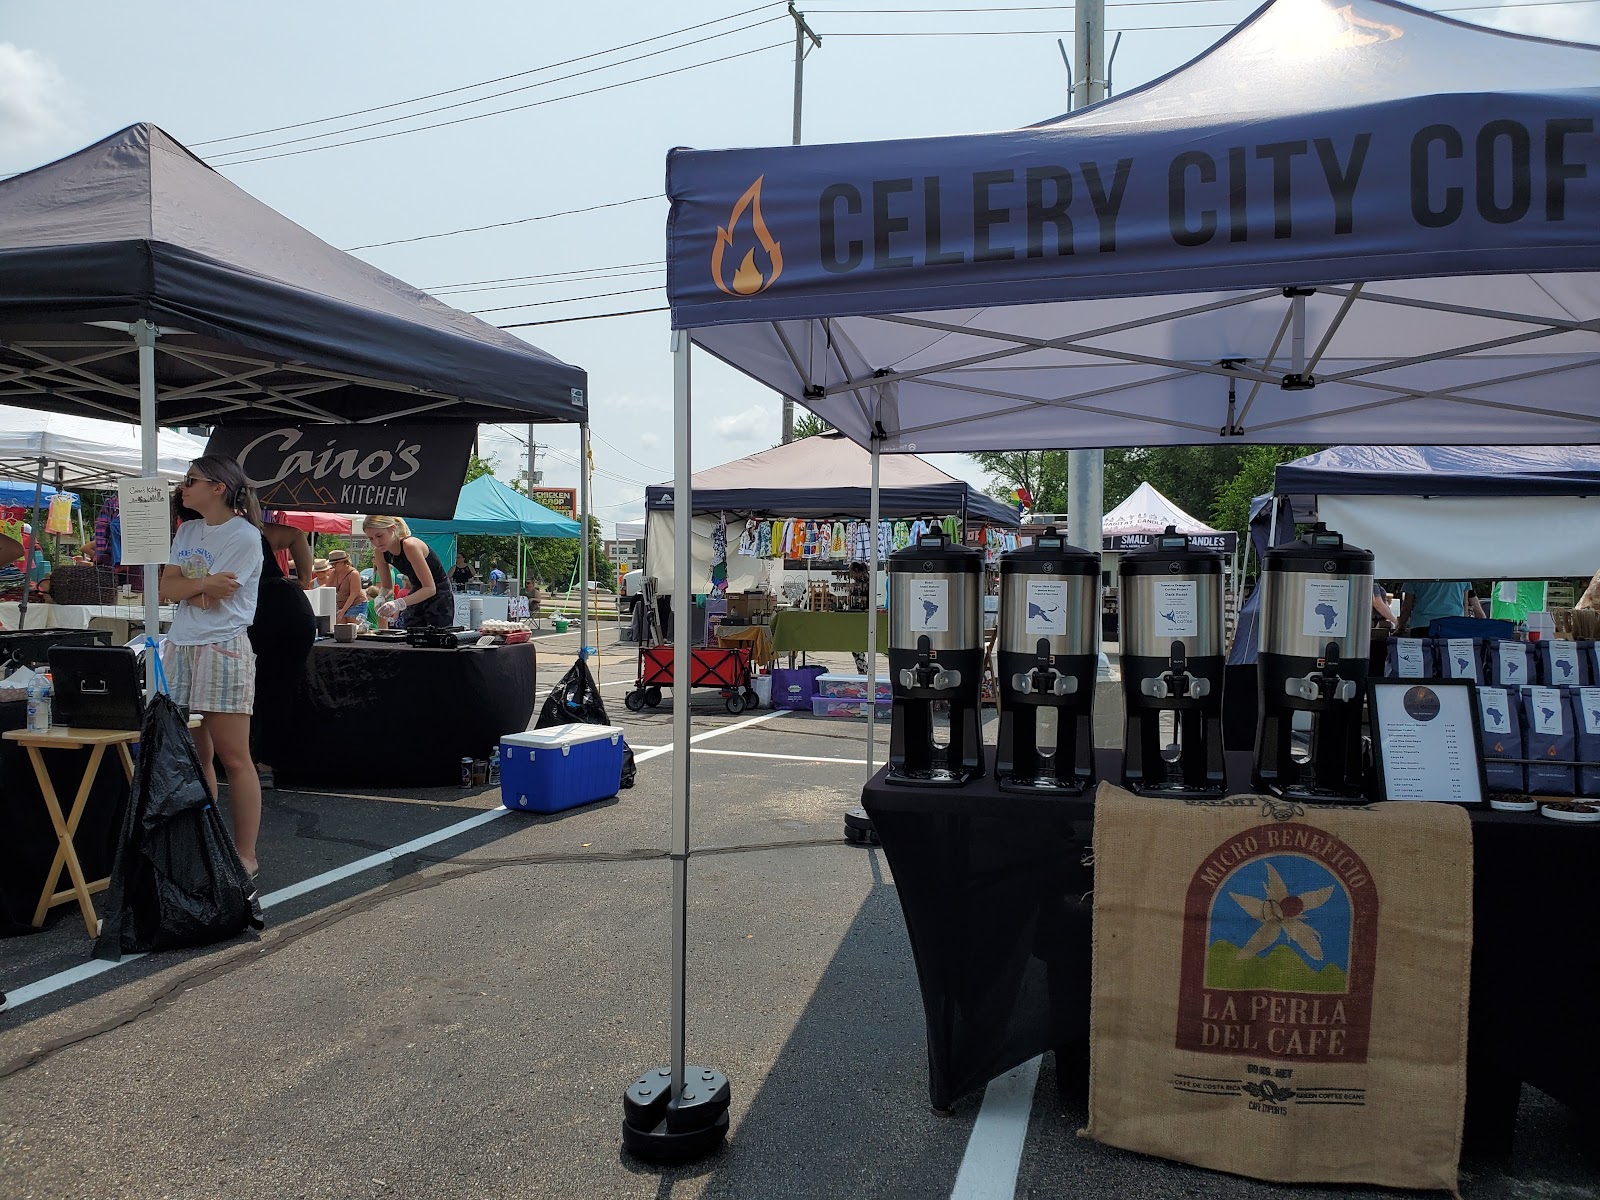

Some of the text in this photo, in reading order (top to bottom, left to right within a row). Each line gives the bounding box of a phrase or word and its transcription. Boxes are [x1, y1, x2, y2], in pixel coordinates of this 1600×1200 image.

[819, 118, 1594, 275] CELERY CITY COF
[236, 428, 421, 489] Caino's
[340, 484, 408, 507] KITCHEN
[1121, 535, 1150, 545] SMALL
[1201, 829, 1367, 889] MICRO BENEFICIO
[1202, 994, 1347, 1025] LA PERLA
[1201, 1022, 1346, 1056] DEL CAFE
[1262, 1104, 1288, 1116] IMPORTS
